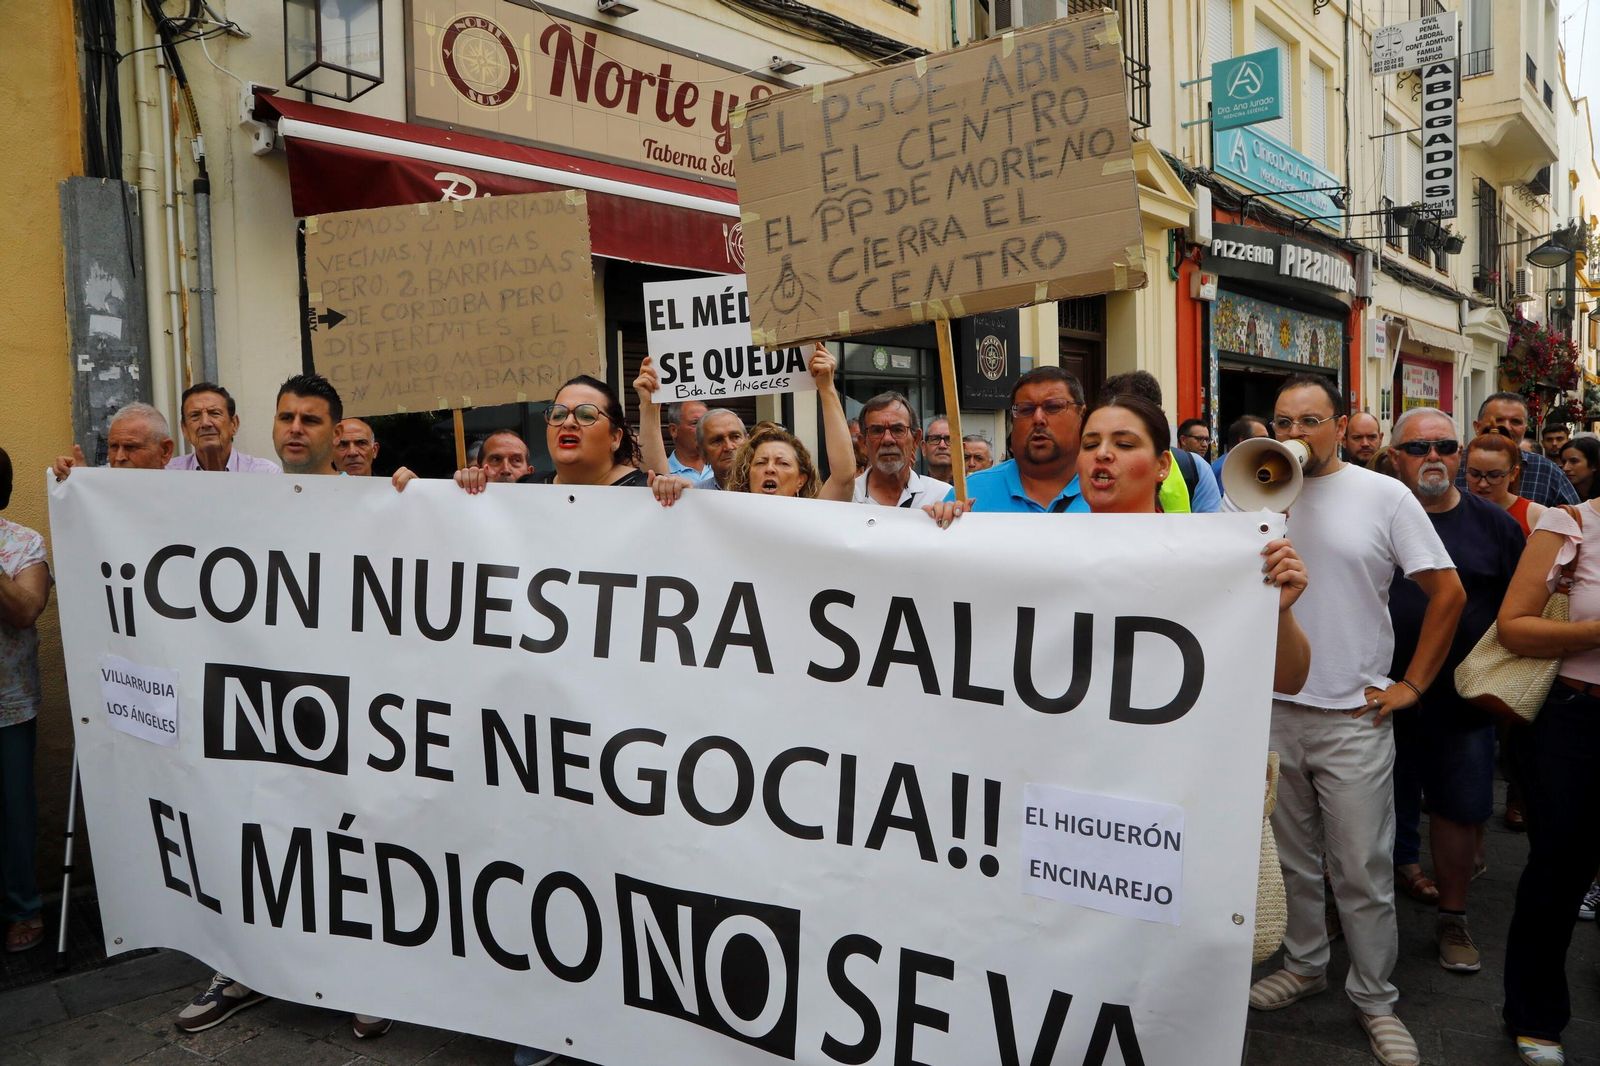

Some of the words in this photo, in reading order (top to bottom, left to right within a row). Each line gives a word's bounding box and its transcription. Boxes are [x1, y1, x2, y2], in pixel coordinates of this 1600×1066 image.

[1415, 31, 1444, 42] LABORAL
[1419, 23, 1441, 33] PENAL
[1422, 16, 1438, 25] CIVIL
[1405, 42, 1425, 52] CONT.
[1425, 35, 1455, 48] ADMTVO.
[1416, 45, 1443, 57] FAMILIA
[466, 89, 502, 106] SUR
[540, 23, 700, 128] Norte
[711, 90, 739, 155] y
[745, 109, 804, 163] EL
[980, 20, 1118, 105] ABRE
[1232, 102, 1248, 112] Ana
[1249, 96, 1275, 108] Jurado
[820, 143, 880, 194] EL
[896, 85, 1090, 173] CENTRO
[1423, 63, 1453, 198] ABOGADOS
[642, 137, 708, 172] Taberna
[765, 214, 808, 255] EL
[820, 197, 874, 243] PP
[882, 170, 932, 216] DE
[947, 126, 1115, 200] MORENO
[982, 187, 1042, 228] EL
[1423, 200, 1444, 210] Portal
[1445, 199, 1456, 207] 11
[319, 213, 407, 247] SOMOS
[441, 229, 541, 264] AMIGAS
[854, 230, 1068, 318] CENTRO
[341, 304, 372, 329] DE
[499, 280, 564, 312] PERO
[648, 298, 684, 332] EL
[530, 314, 570, 337] EL
[330, 350, 440, 384] CENTRO
[659, 351, 695, 385] SE
[703, 344, 807, 385] QUEDA
[675, 384, 706, 399] Bda.
[733, 377, 791, 393] ANGELES
[351, 554, 775, 676] NUESTRA
[806, 588, 1205, 726] SALUD
[101, 668, 175, 699] VILLARRUBIA
[106, 701, 129, 718] LOS
[130, 704, 176, 734] ÁNGELES
[222, 676, 340, 762] NO
[366, 692, 454, 783] SE
[481, 708, 1002, 879] NEGOCIA!!
[1025, 806, 1049, 828] EL
[1054, 811, 1182, 852] HIGUERÓN
[1029, 858, 1174, 906] ENCINAREJO
[148, 797, 223, 916] EL
[240, 812, 604, 984] MÉDICO
[630, 891, 788, 1039] NO
[820, 933, 956, 1066] SE
